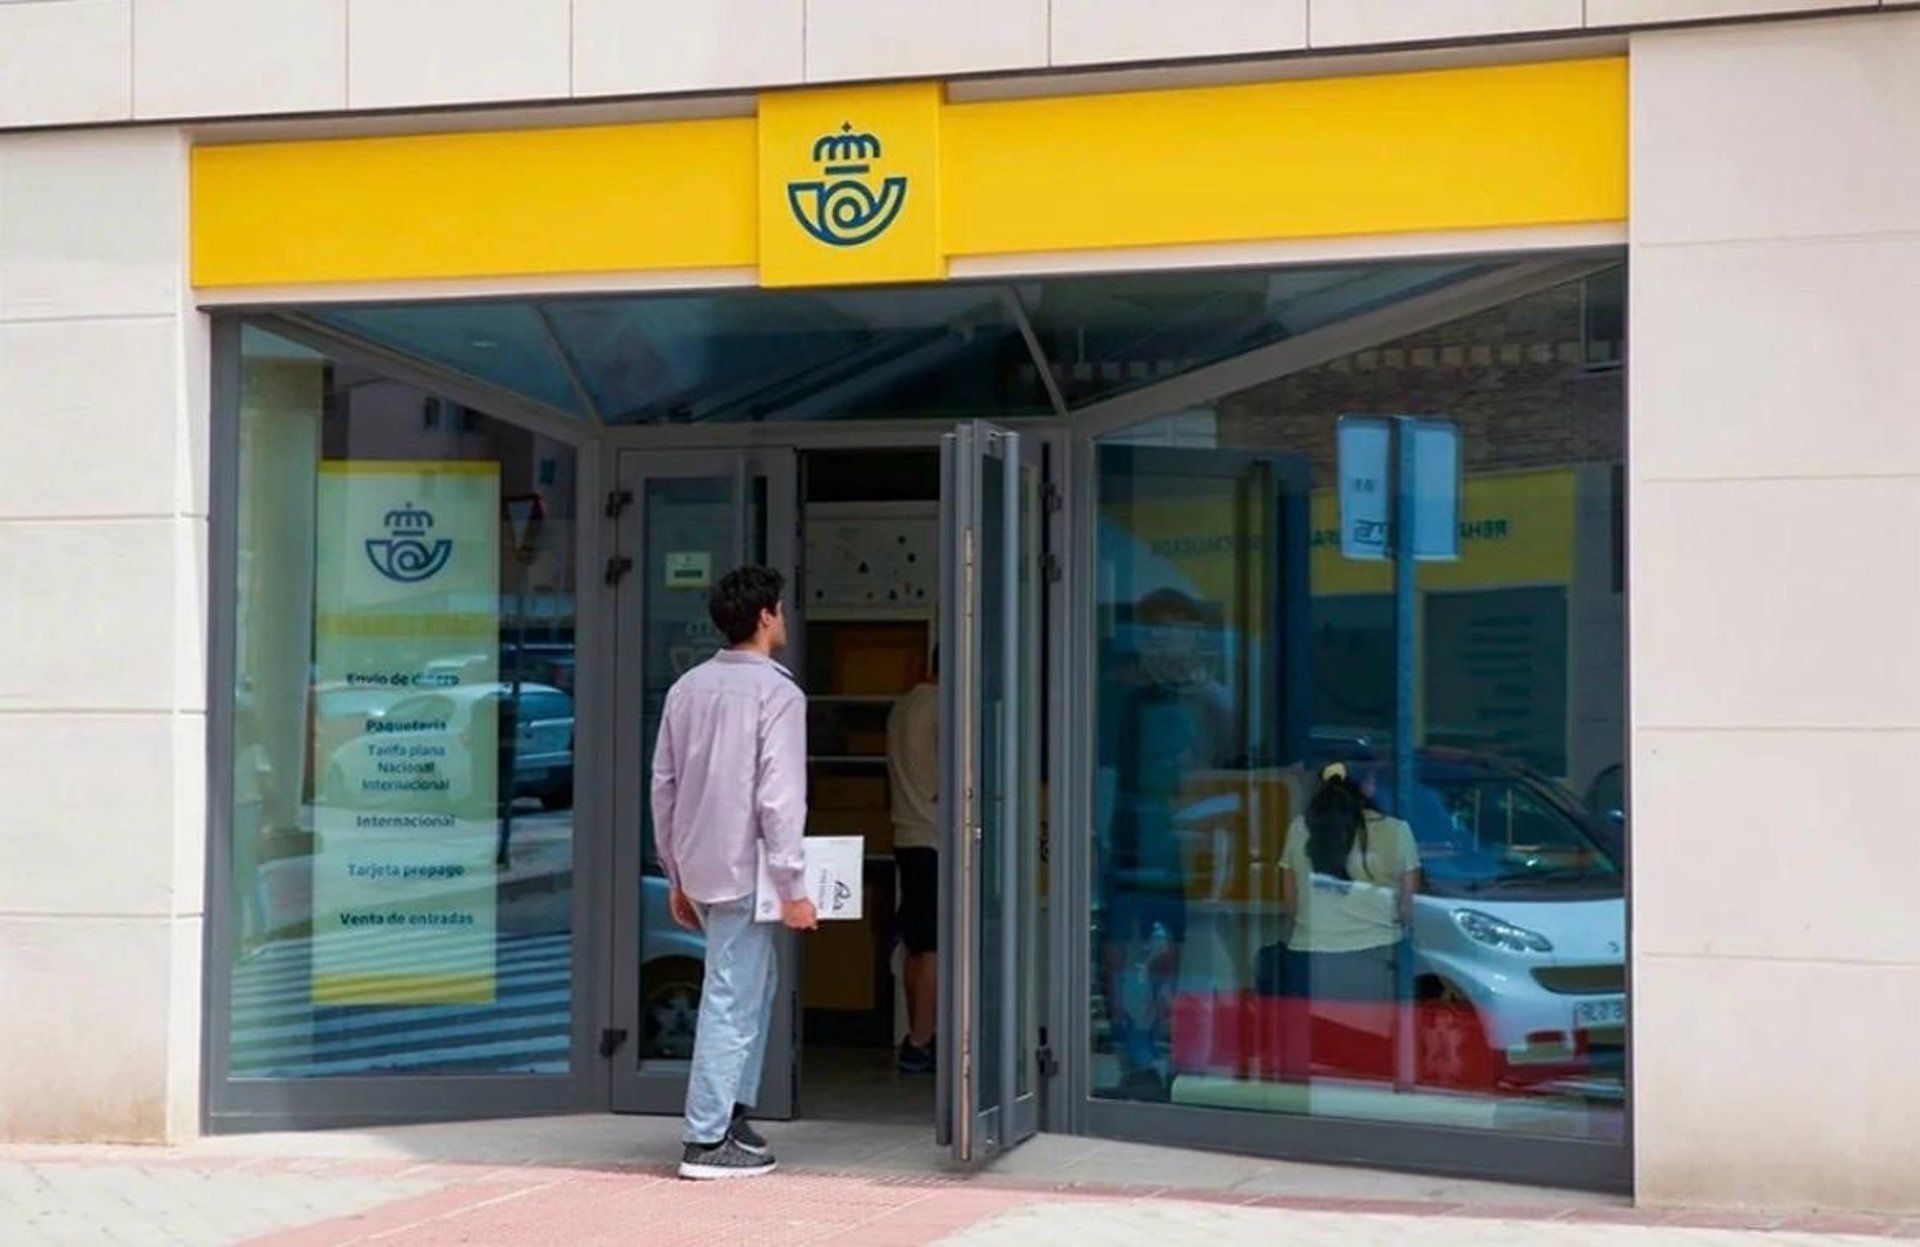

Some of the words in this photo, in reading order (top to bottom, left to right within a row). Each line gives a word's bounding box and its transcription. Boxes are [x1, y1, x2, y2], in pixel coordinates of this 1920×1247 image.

[390, 671, 409, 685] de
[378, 761, 435, 773] Nacional
[362, 777, 449, 790] Internacional
[356, 814, 456, 827] Internacional
[347, 863, 400, 878] Tarjeta
[340, 912, 384, 925] Venta
[386, 911, 406, 925] de
[408, 911, 474, 925] entradas
